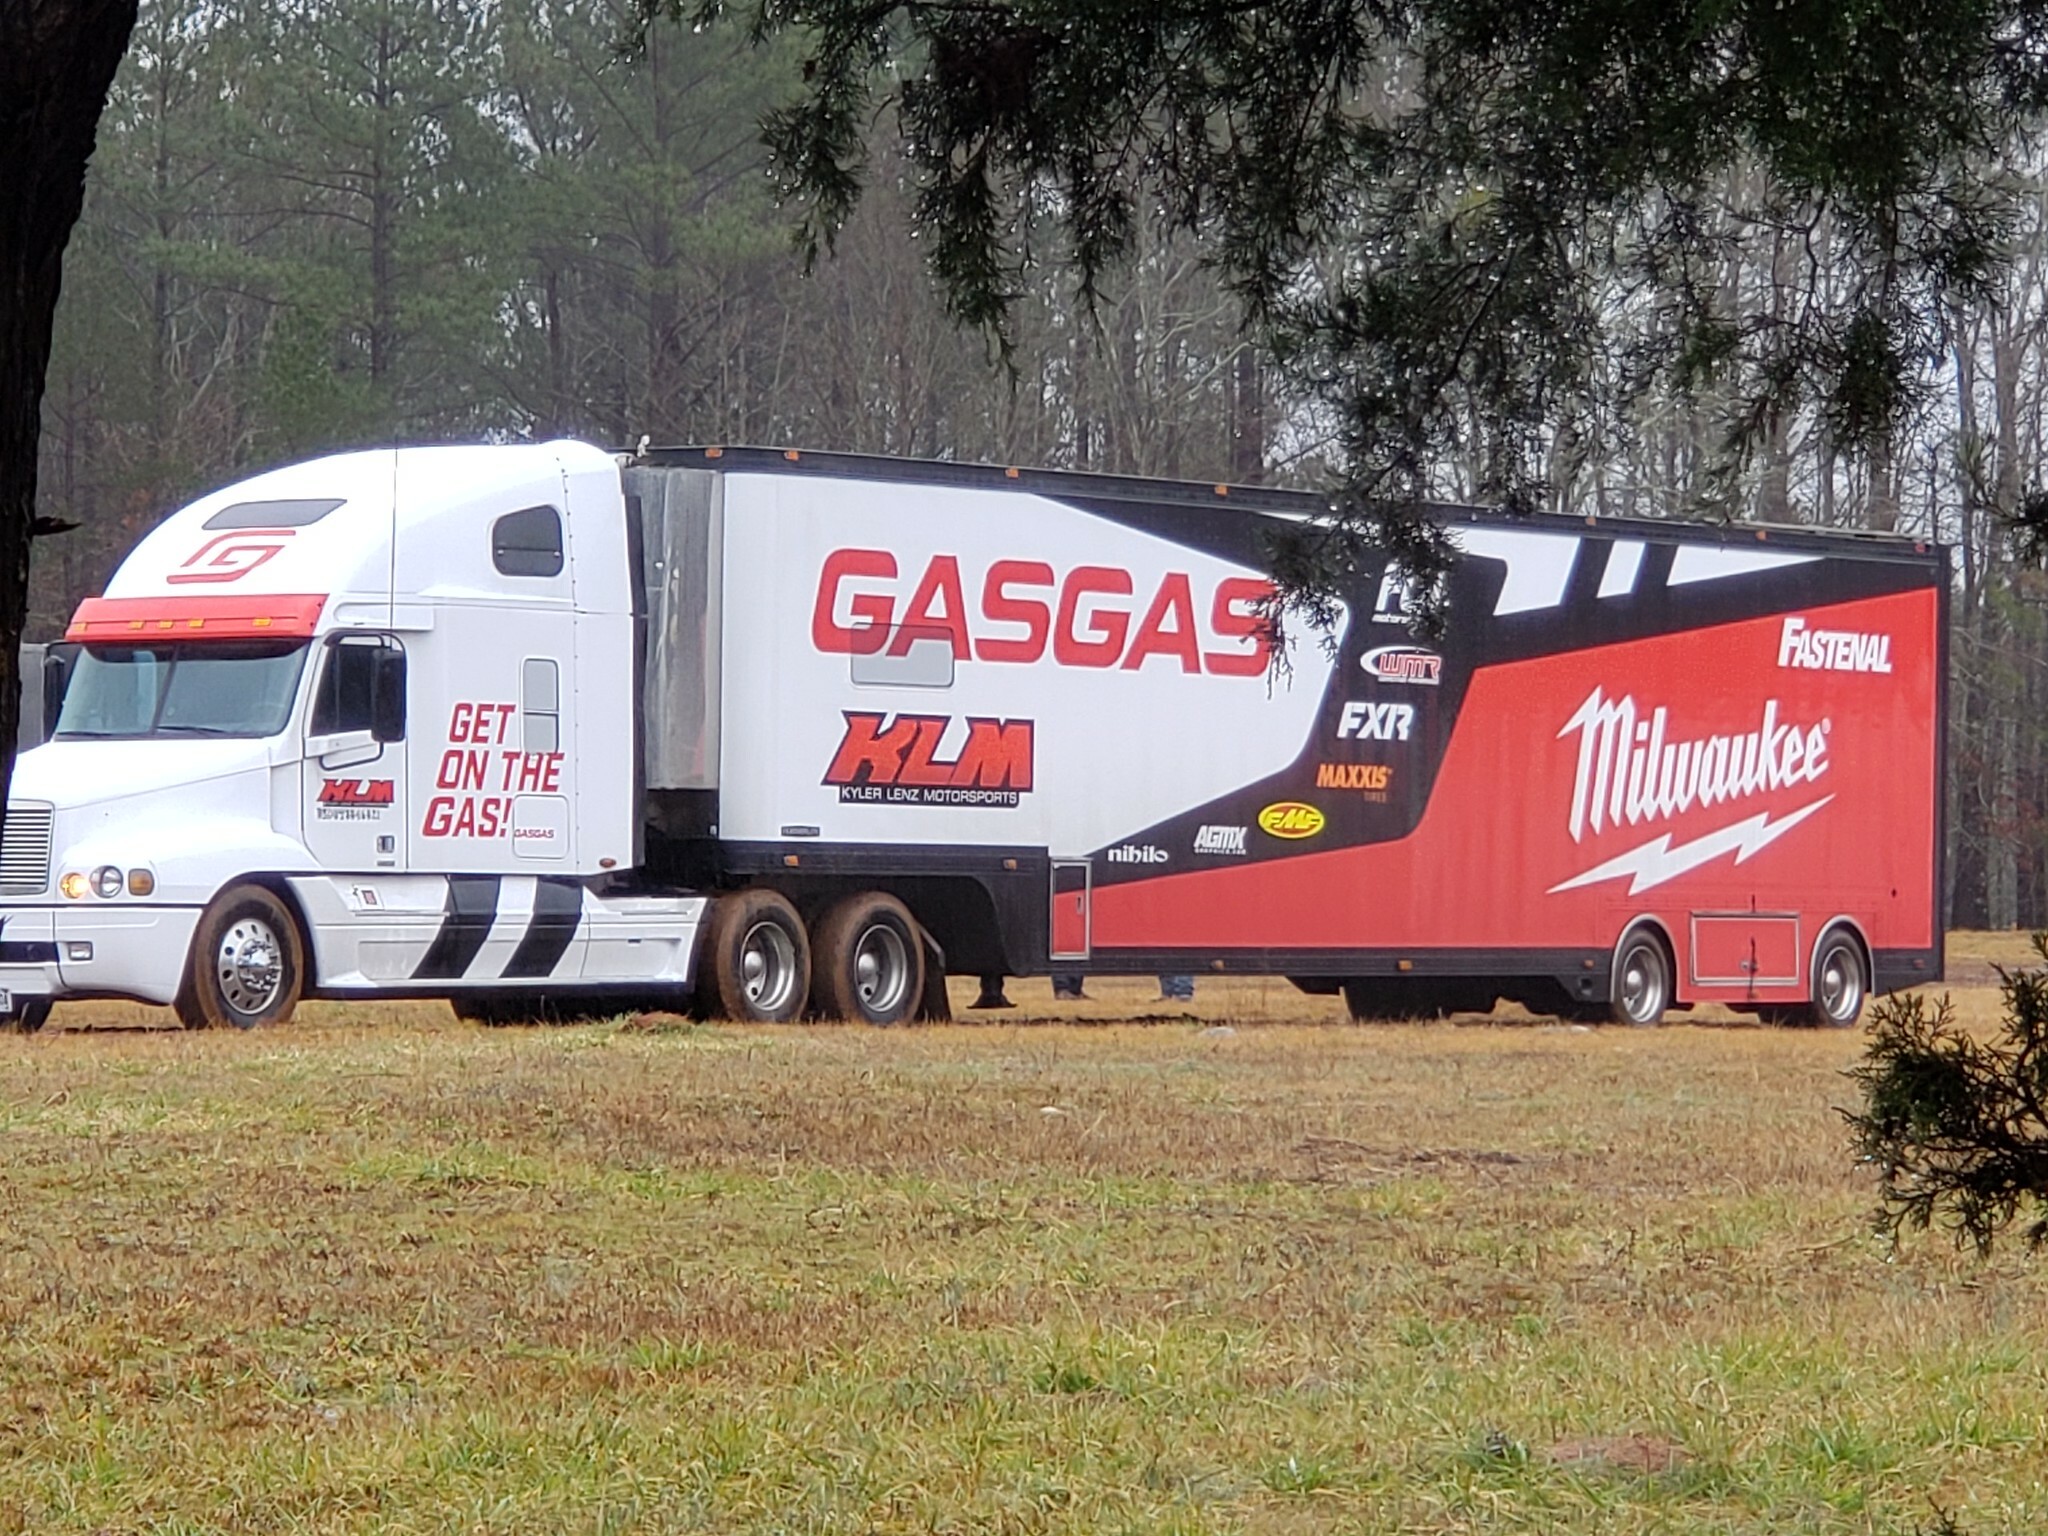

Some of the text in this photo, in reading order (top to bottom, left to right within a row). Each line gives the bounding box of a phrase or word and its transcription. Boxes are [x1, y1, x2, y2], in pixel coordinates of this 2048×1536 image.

[811, 548, 1277, 677] GASGAS
[449, 702, 516, 744] GET
[1336, 701, 1414, 741] FXR
[436, 749, 565, 792] ON THE
[820, 710, 1035, 793] KLM
[1556, 684, 1830, 845] Milwaukee
[316, 778, 395, 803] KLM
[841, 786, 1018, 804] KYLER LENZ MOTORSPORTS
[1316, 763, 1389, 789] MAXXIS
[422, 796, 513, 838] GAS!
[513, 829, 554, 839] GASGAS
[1264, 808, 1319, 830] FMF
[1107, 844, 1170, 864] nihilo
